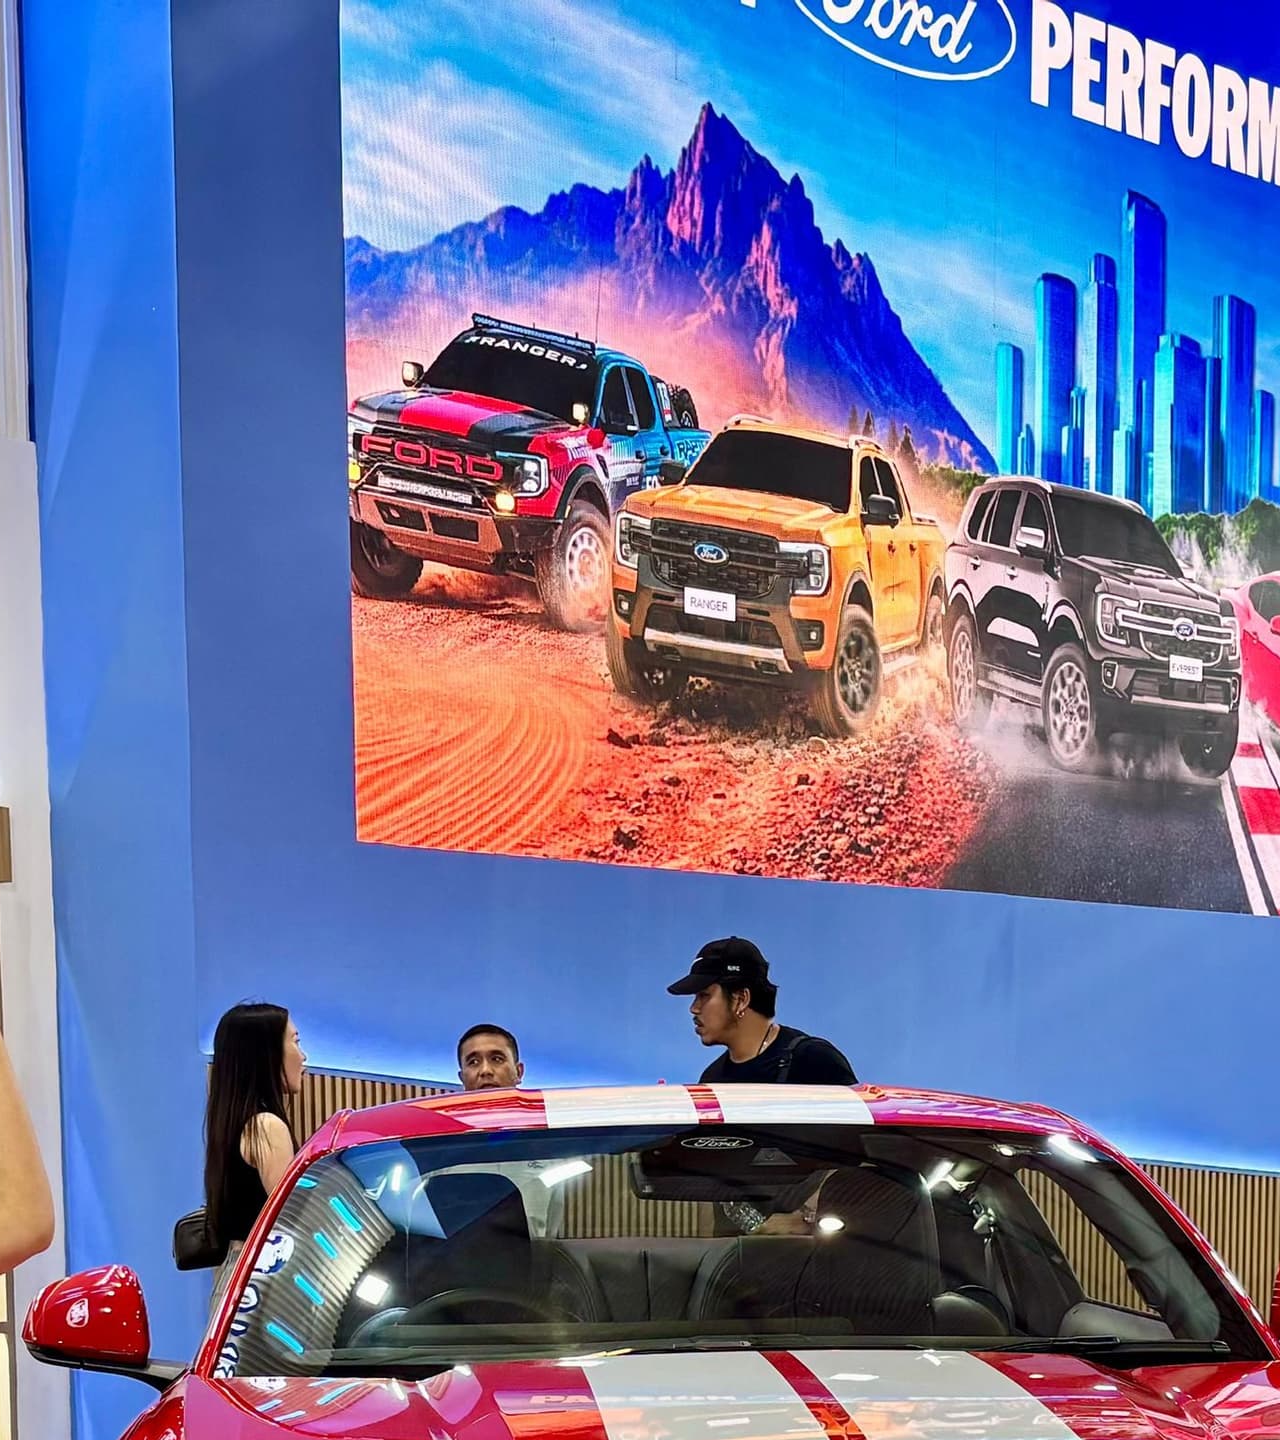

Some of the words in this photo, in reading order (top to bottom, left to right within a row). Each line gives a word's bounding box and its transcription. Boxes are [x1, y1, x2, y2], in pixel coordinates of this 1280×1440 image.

[480, 336, 577, 367] RANGER
[361, 435, 504, 481] FORD
[689, 596, 728, 612] RANGER
